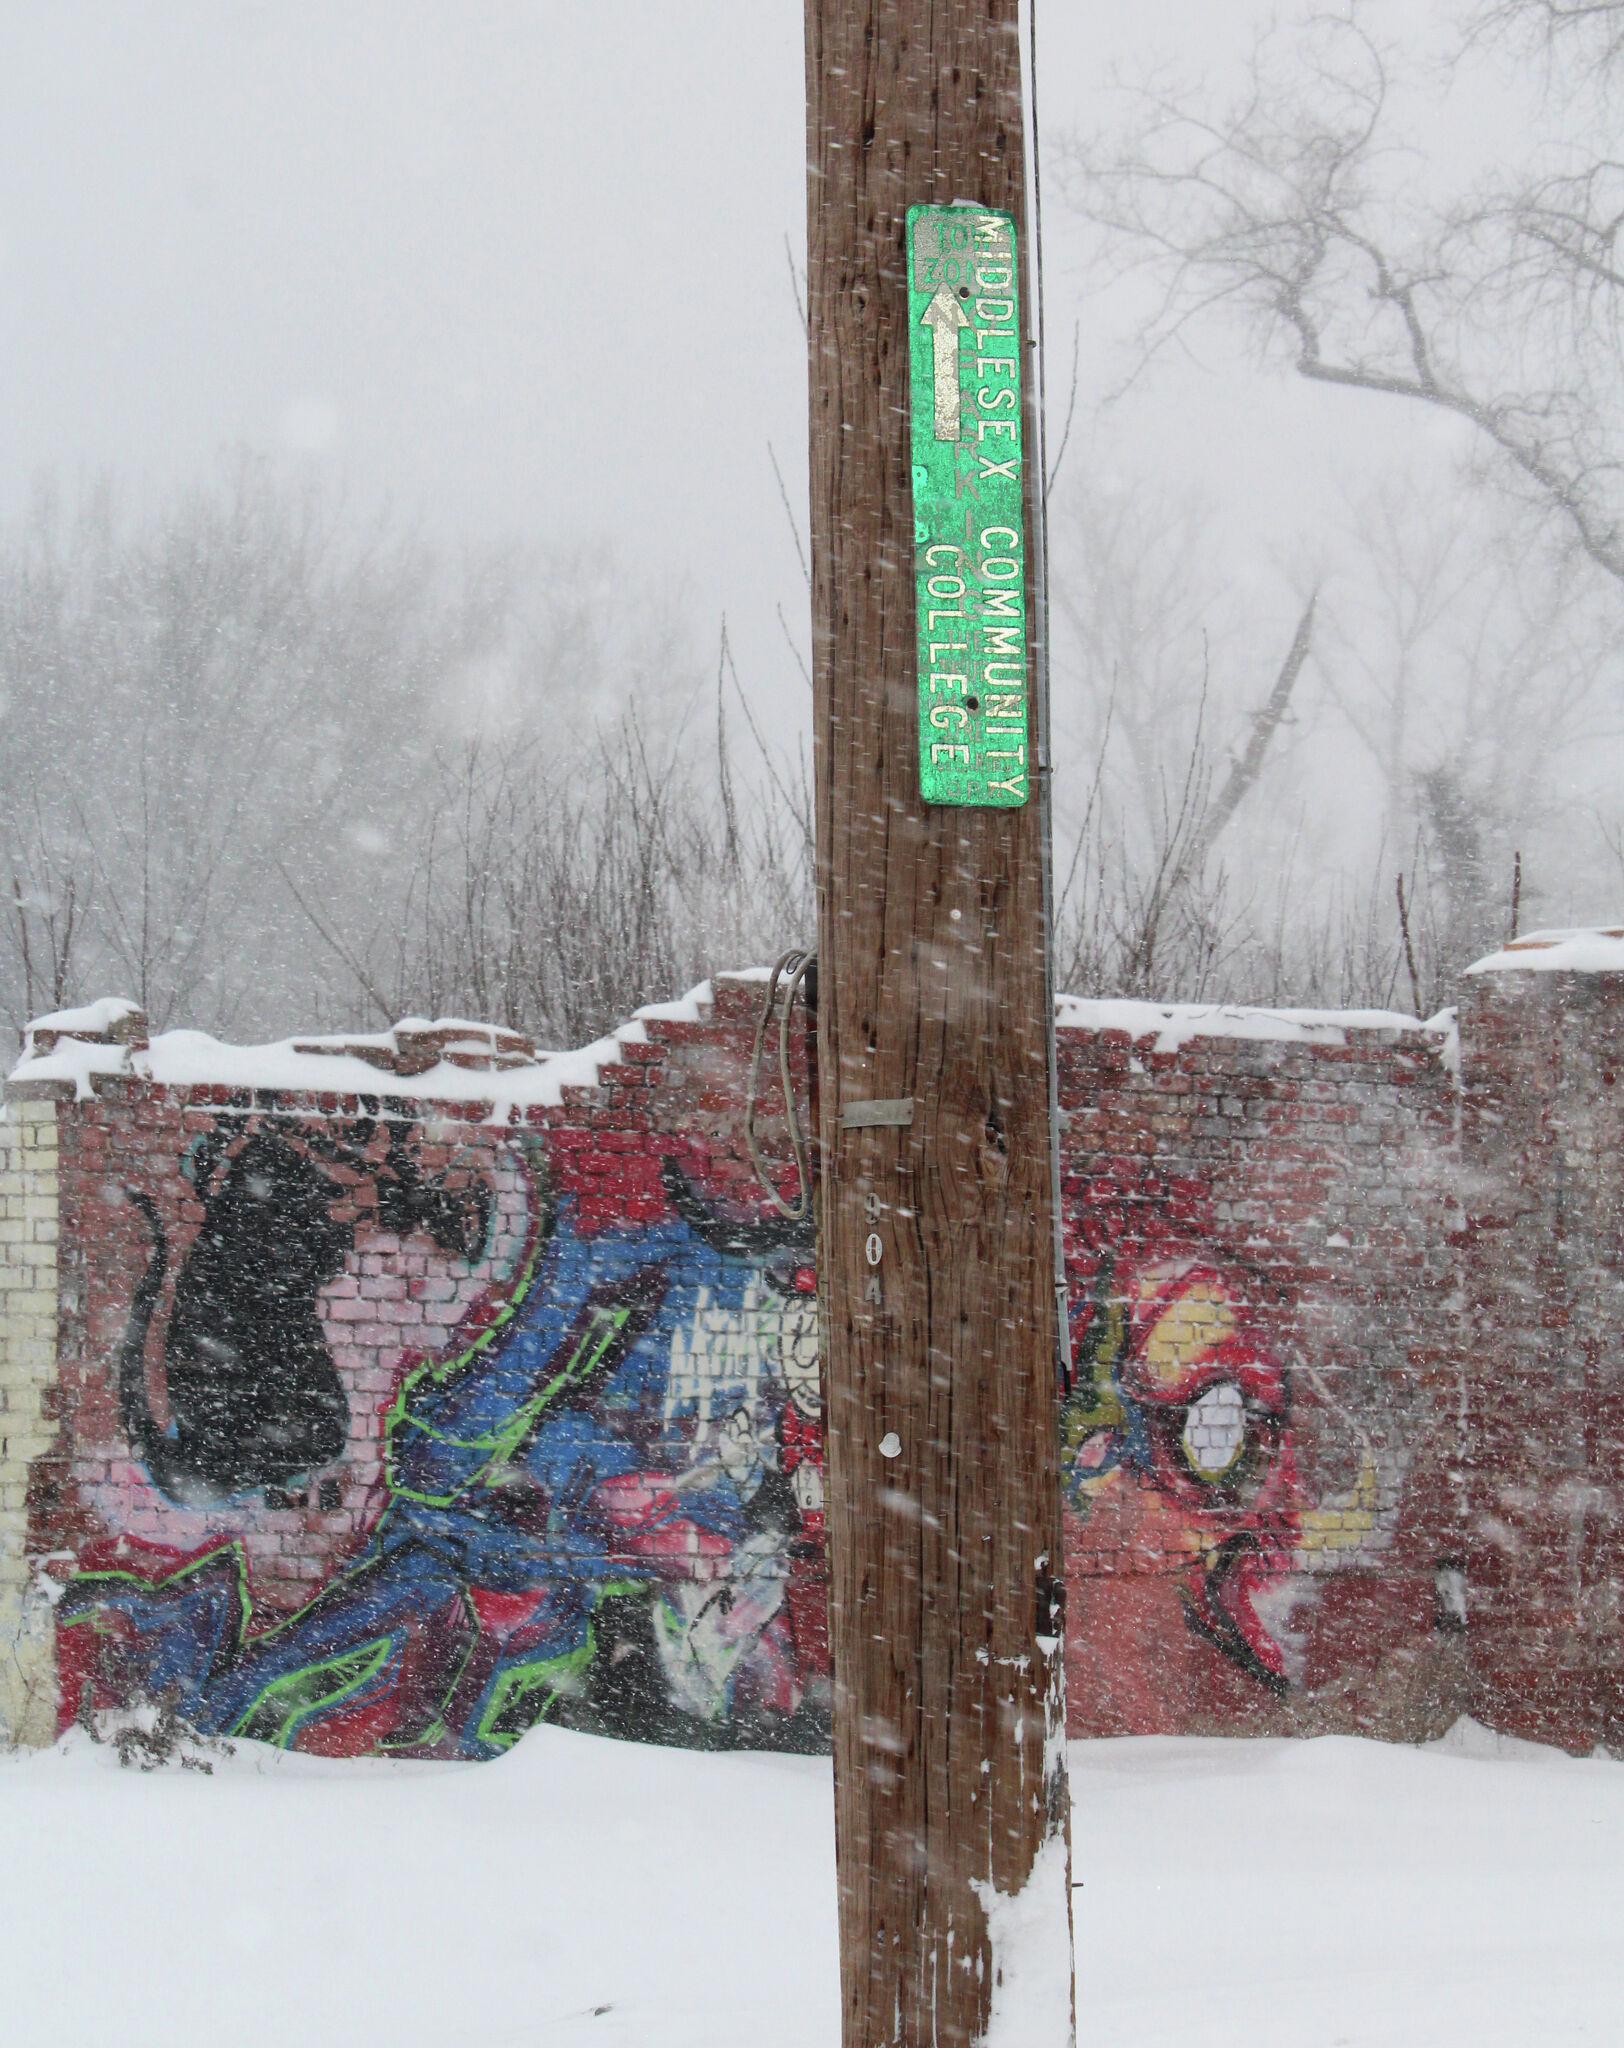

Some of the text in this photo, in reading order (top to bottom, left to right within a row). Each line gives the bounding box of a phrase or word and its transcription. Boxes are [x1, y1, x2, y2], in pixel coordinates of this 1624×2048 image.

[925, 543, 970, 765] COLLEGE
[974, 215, 1025, 798] MIDDLESEX COMMUNITY
